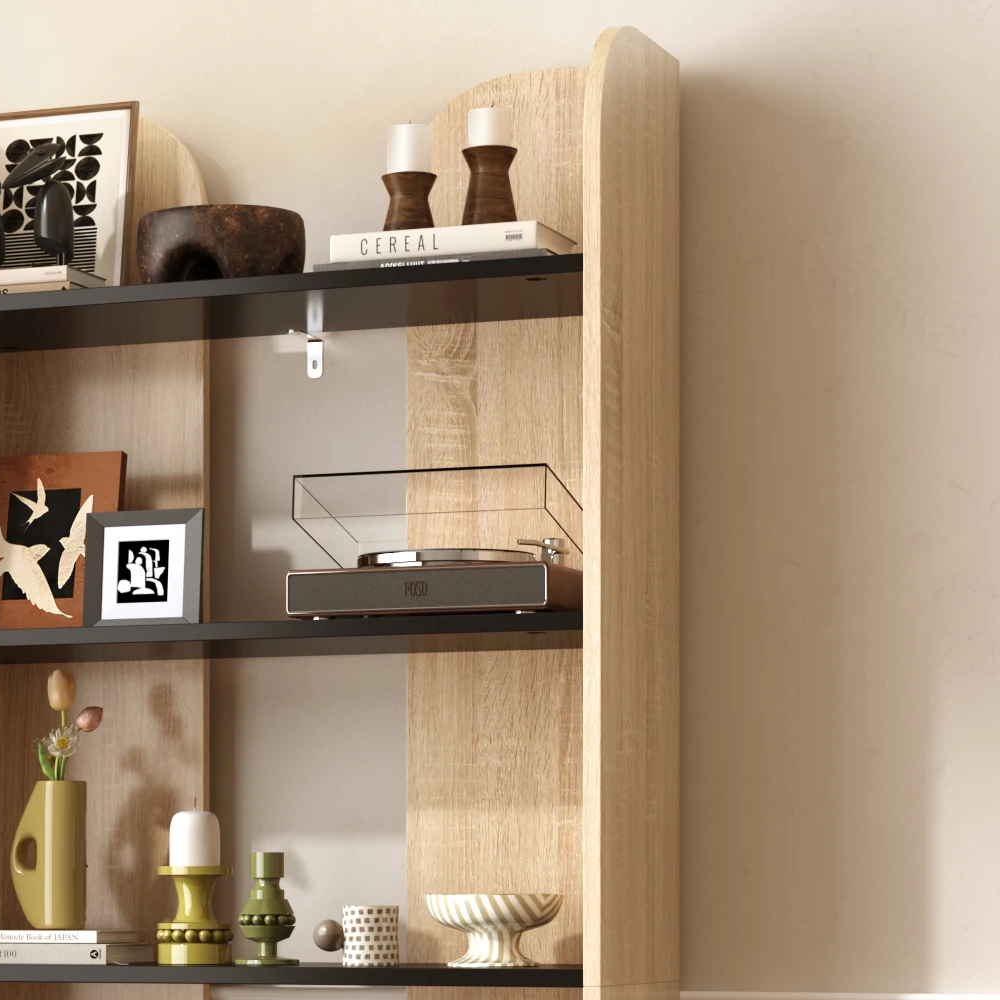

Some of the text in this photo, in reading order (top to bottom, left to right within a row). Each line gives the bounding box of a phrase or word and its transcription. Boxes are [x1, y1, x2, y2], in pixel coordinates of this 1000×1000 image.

[360, 234, 439, 255] CEREAL
[26, 933, 43, 941] Book
[44, 933, 52, 941] of
[53, 933, 79, 941] JAPAN
[3, 949, 17, 958] 100
